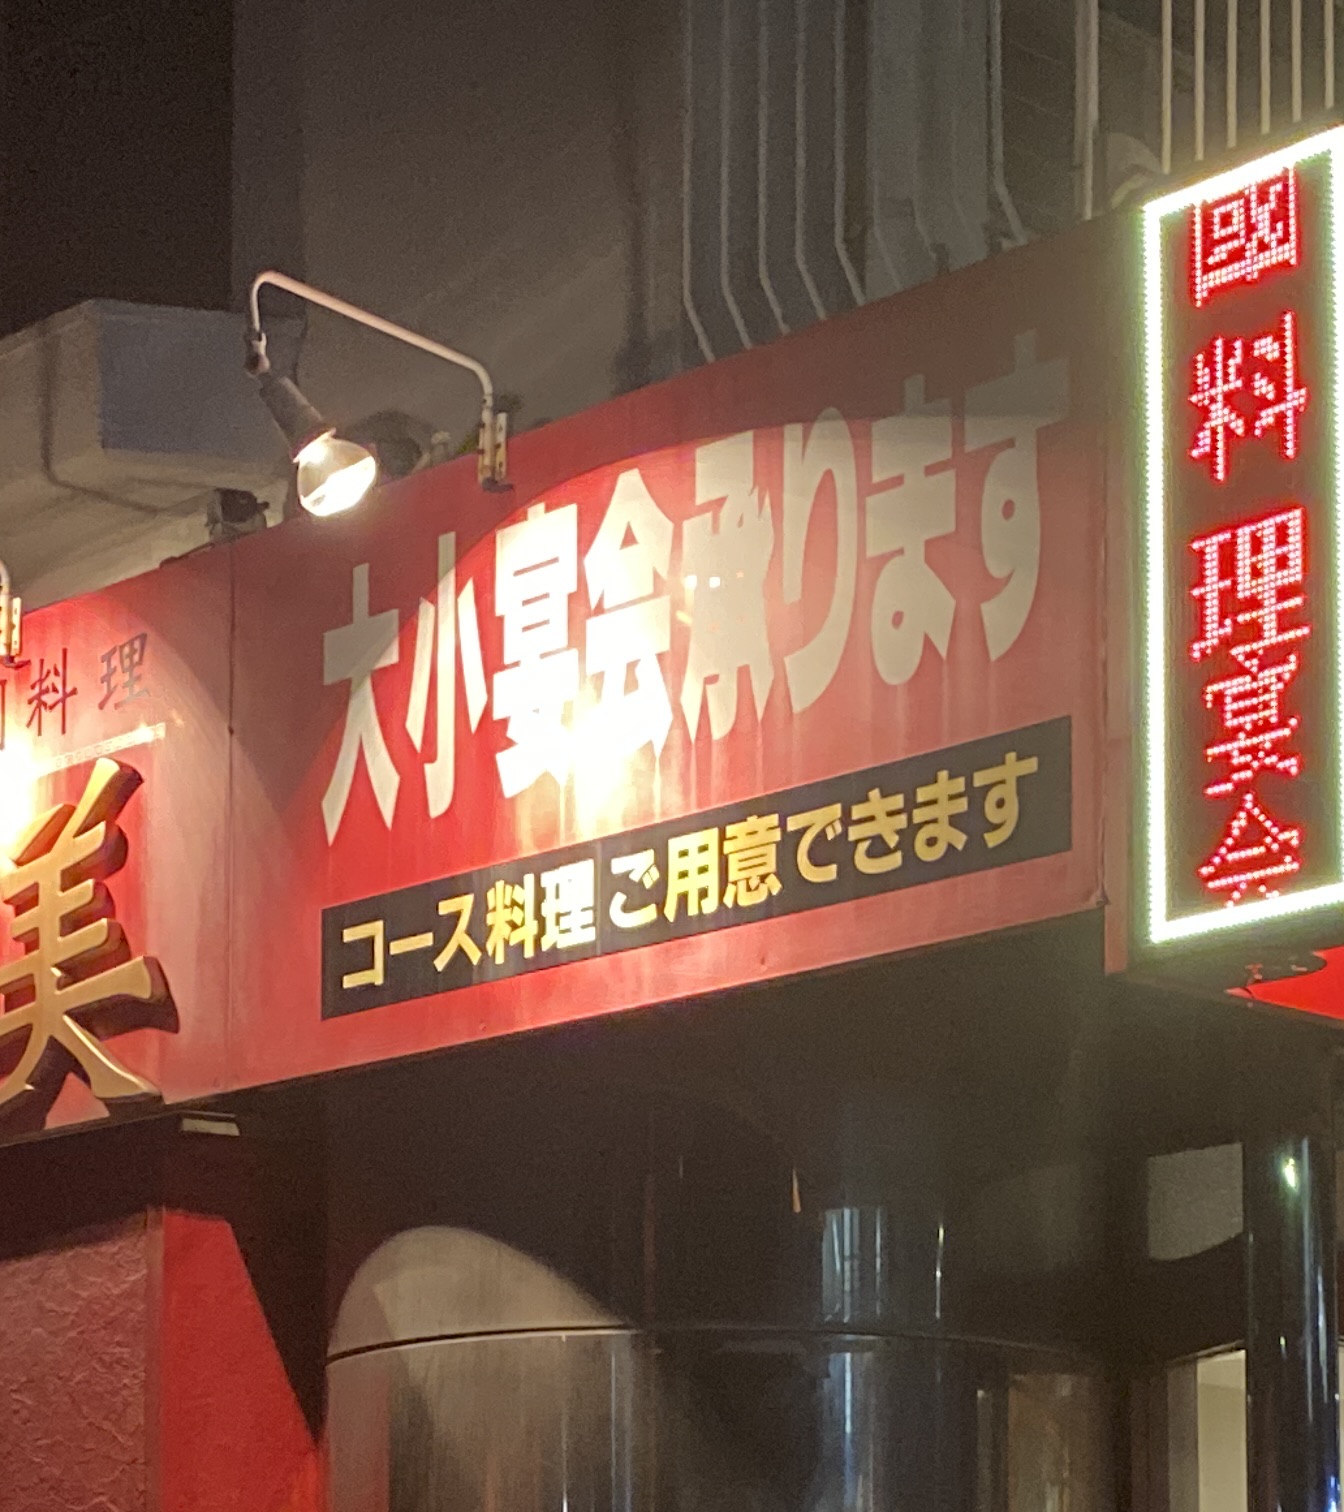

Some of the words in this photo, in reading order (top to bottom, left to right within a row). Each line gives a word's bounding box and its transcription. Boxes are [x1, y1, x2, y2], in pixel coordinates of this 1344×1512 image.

[321, 330, 1072, 846] 大小宴会承ります
[341, 858, 596, 990] コース料理
[609, 751, 1039, 930] ご用意できます
